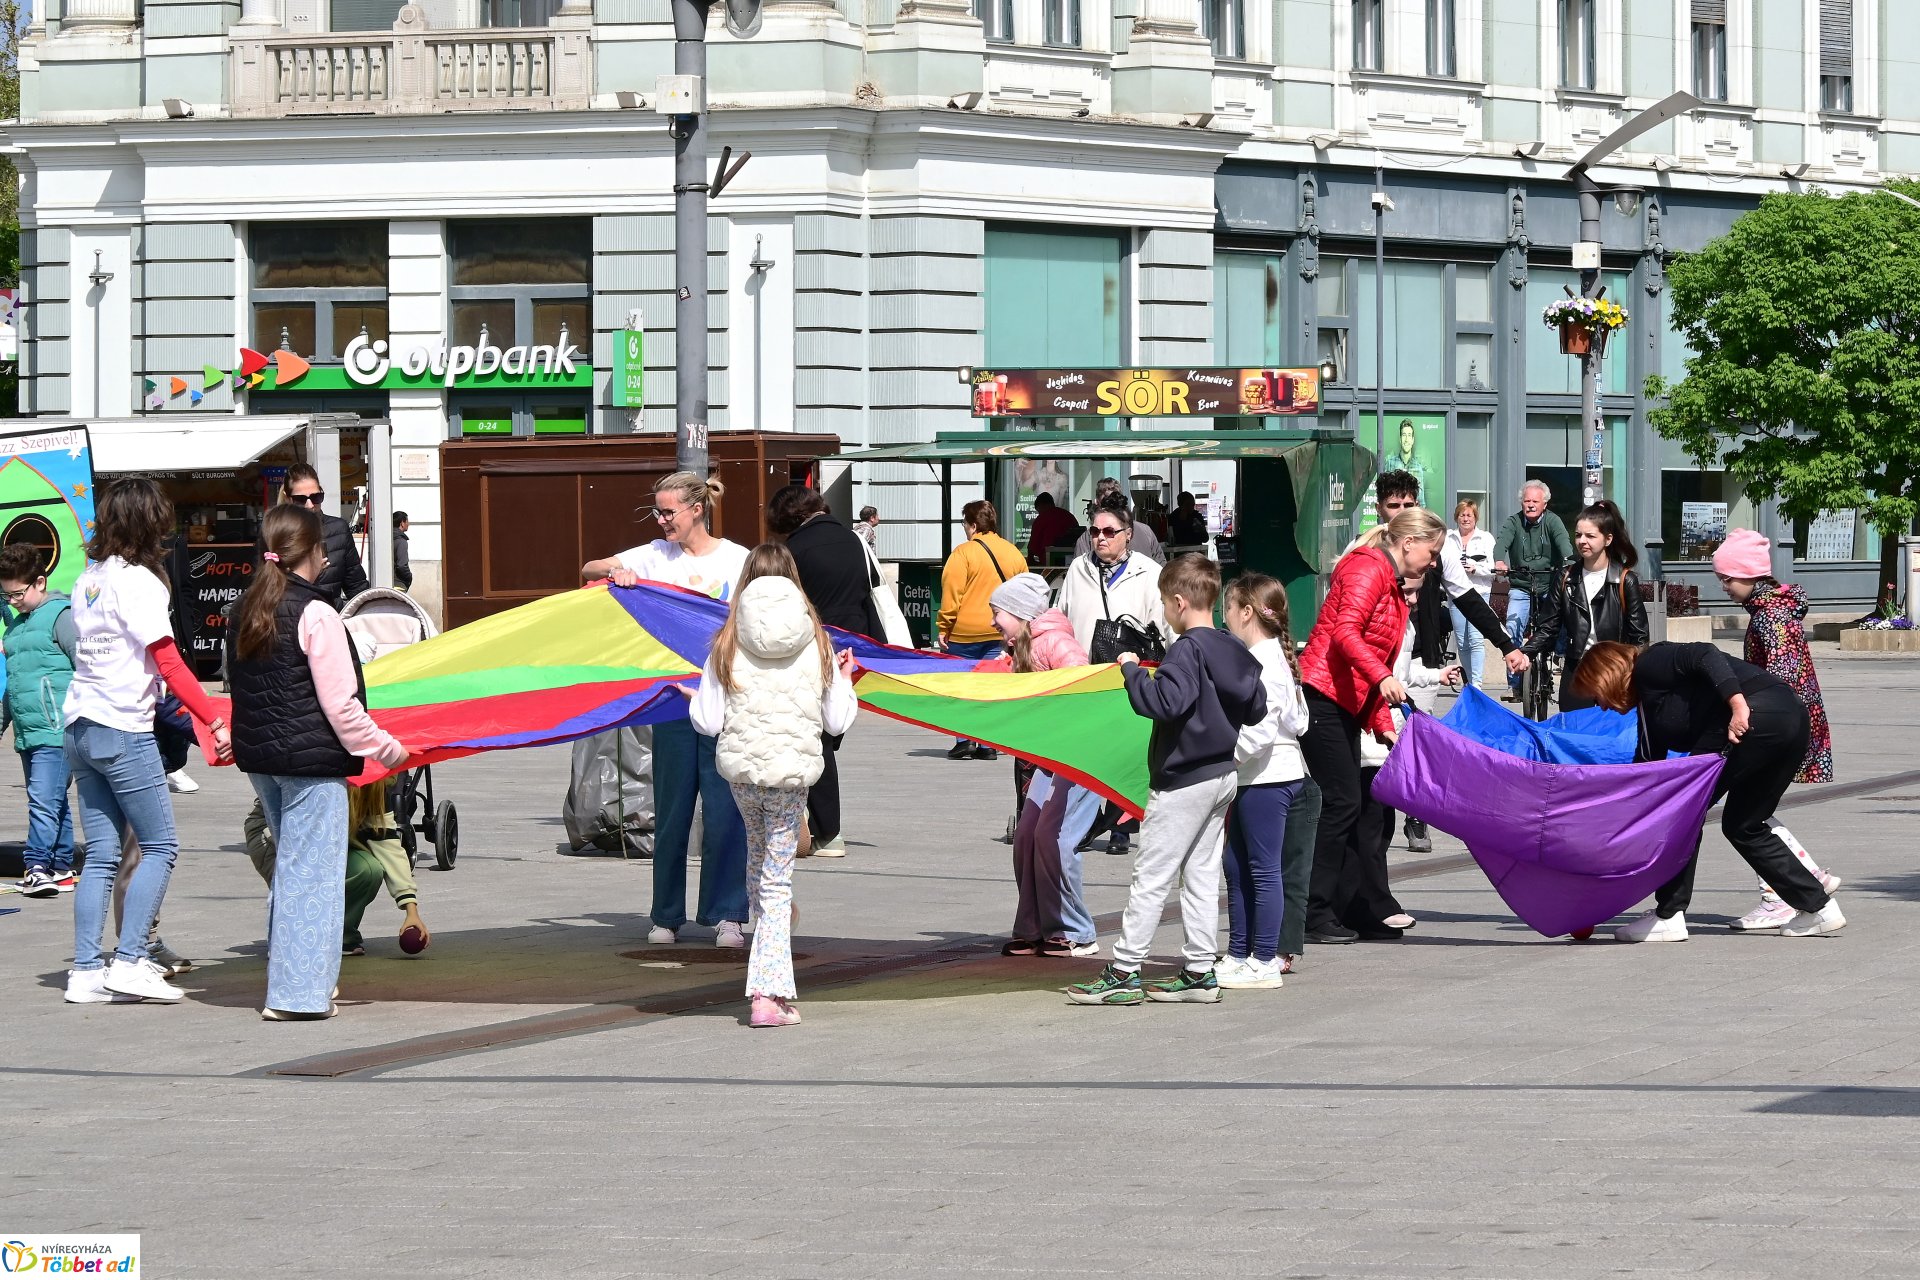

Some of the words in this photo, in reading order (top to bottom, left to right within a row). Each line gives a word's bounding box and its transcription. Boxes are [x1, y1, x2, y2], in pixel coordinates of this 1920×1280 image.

[401, 331, 577, 387] otpbank
[627, 375, 641, 389] 0-24
[1096, 369, 1191, 415] SÖR
[1053, 396, 1090, 411] Csapolt
[1198, 399, 1220, 411] Beer
[478, 422, 497, 431] 0-24
[1016, 503, 1029, 511] OTP
[903, 602, 930, 618] KRA
[193, 635, 218, 651] ÜLT
